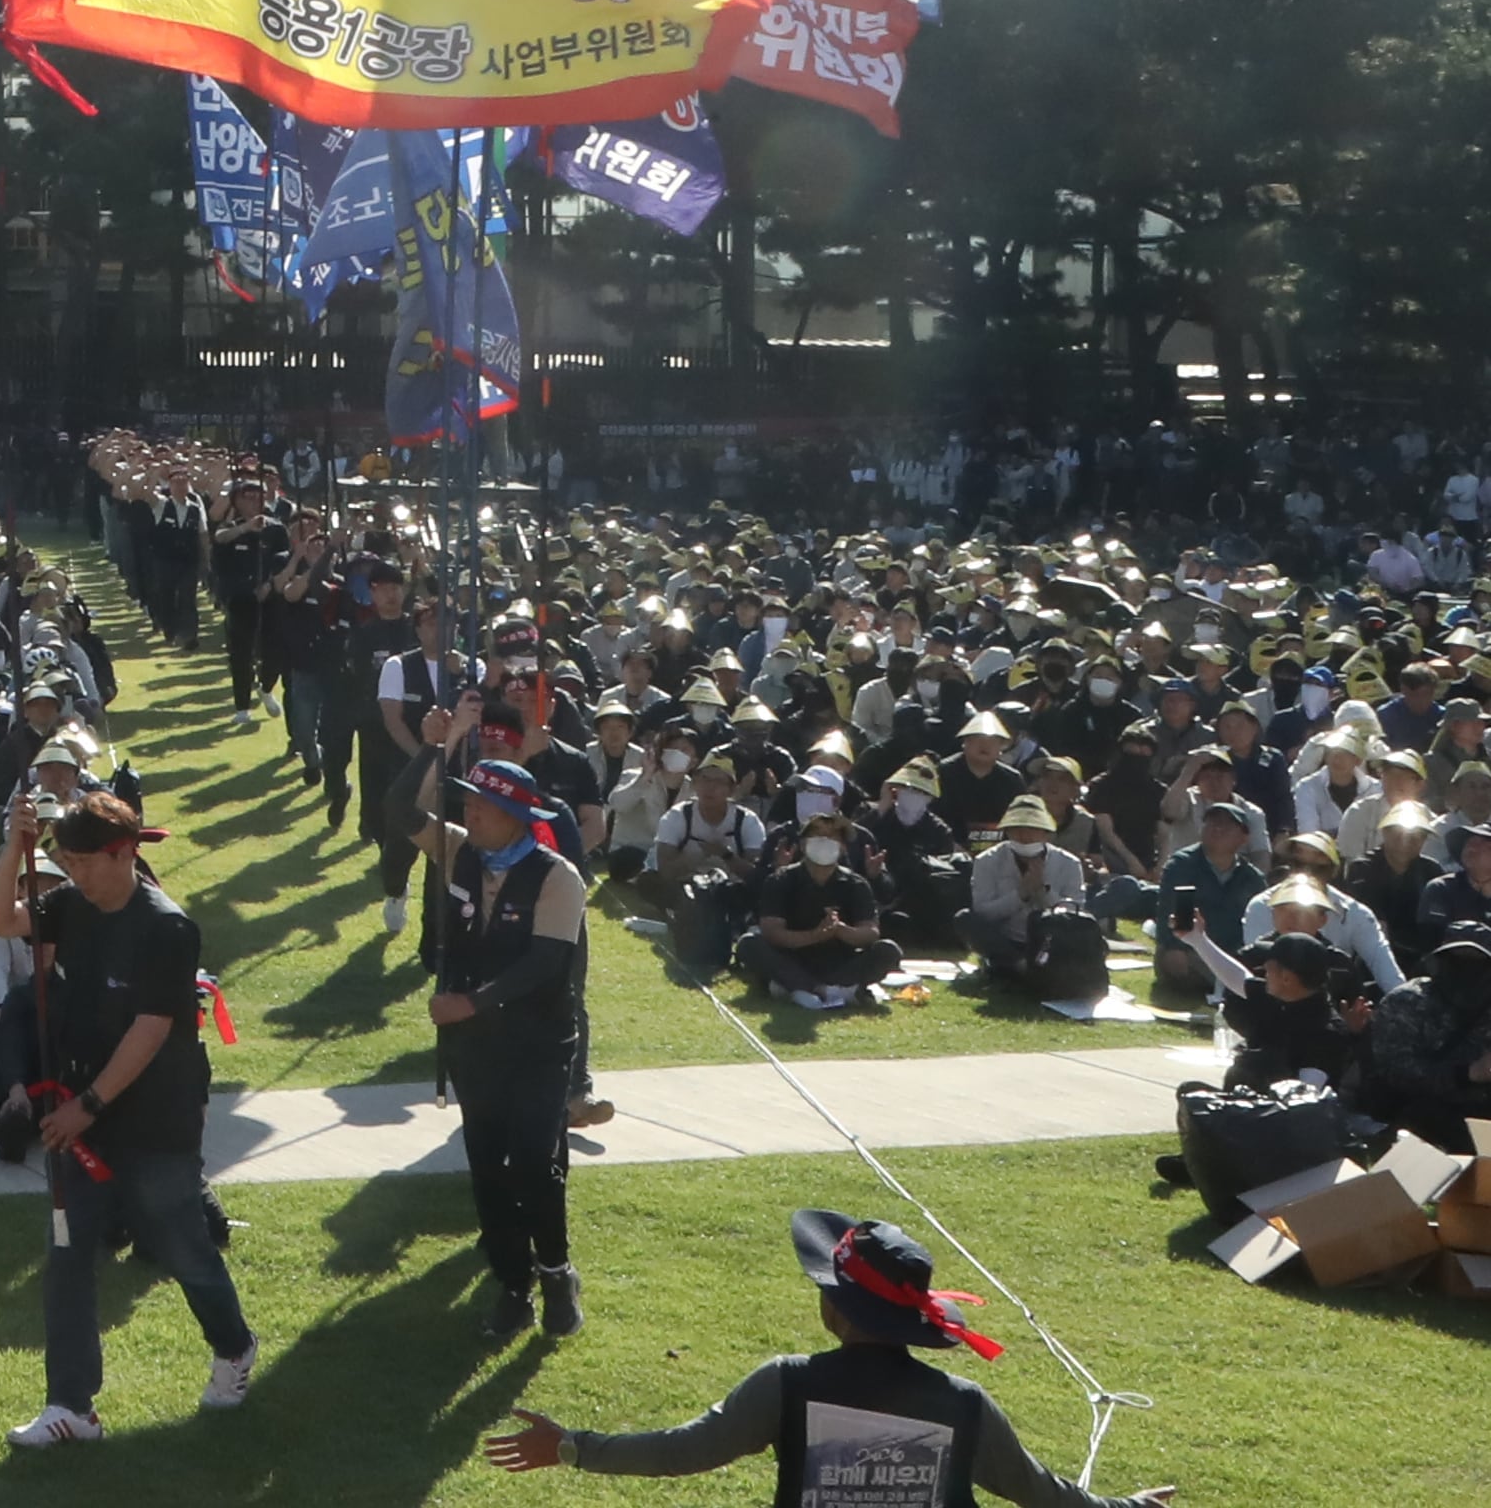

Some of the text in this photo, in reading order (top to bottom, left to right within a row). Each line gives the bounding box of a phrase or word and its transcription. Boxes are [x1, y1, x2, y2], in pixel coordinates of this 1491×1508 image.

[480, 17, 691, 80] 사업부위원회
[753, 5, 904, 108] 위원회
[870, 1465, 936, 1486] 싸우자
